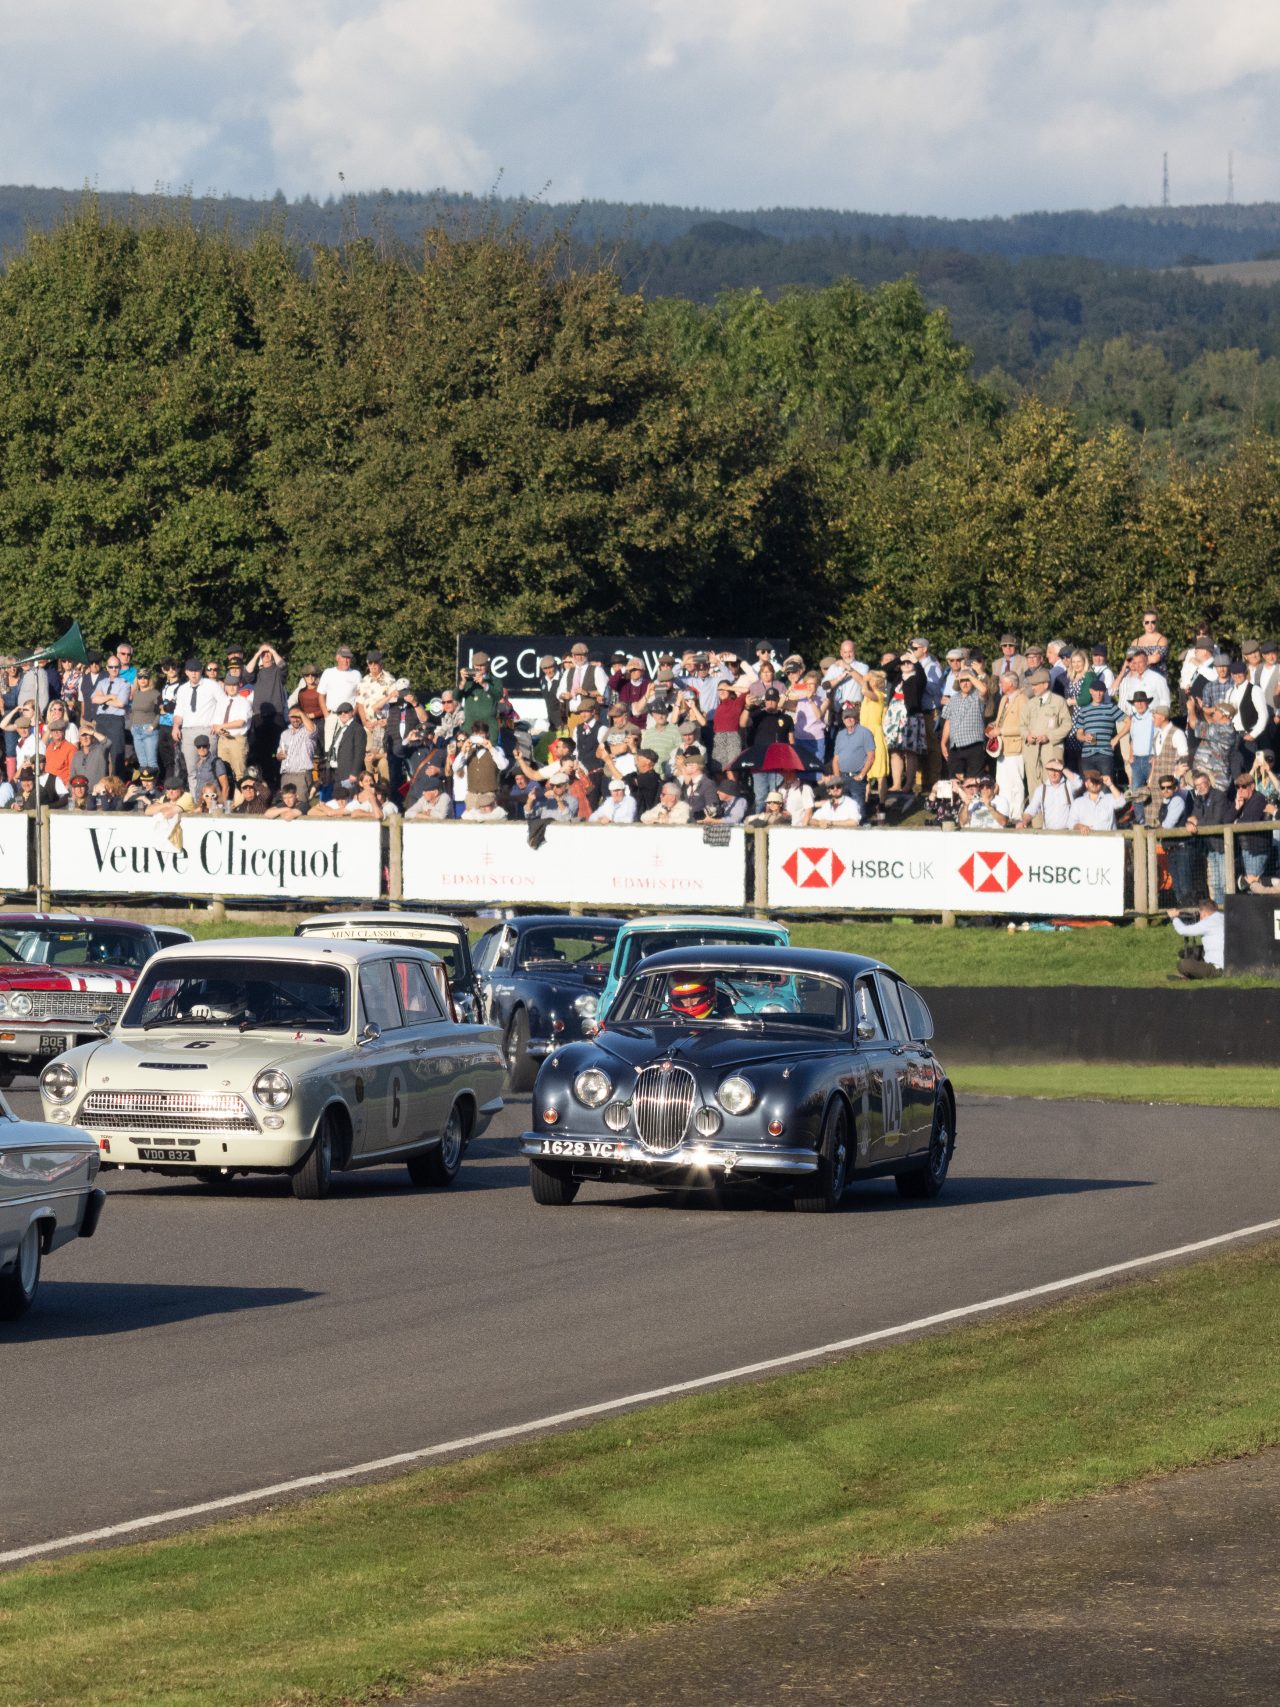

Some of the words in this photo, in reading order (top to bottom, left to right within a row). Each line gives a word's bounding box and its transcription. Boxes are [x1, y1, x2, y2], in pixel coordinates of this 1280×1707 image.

[468, 648, 509, 679] Ie
[86, 827, 189, 874] Veuve
[200, 829, 344, 888] Clicquot
[851, 860, 904, 879] HSBC
[909, 862, 934, 880] UK
[1028, 865, 1081, 885] HSBC
[1086, 868, 1111, 886] UK
[440, 873, 536, 886] EDMISTON
[612, 876, 705, 890] EDMISTON
[331, 931, 354, 939] MINI
[41, 1036, 65, 1047] BOE
[183, 1040, 217, 1049] 6
[392, 1077, 400, 1128] 6
[144, 1149, 165, 1160] VDO
[168, 1150, 191, 1161] 832
[542, 1140, 585, 1156] 1628
